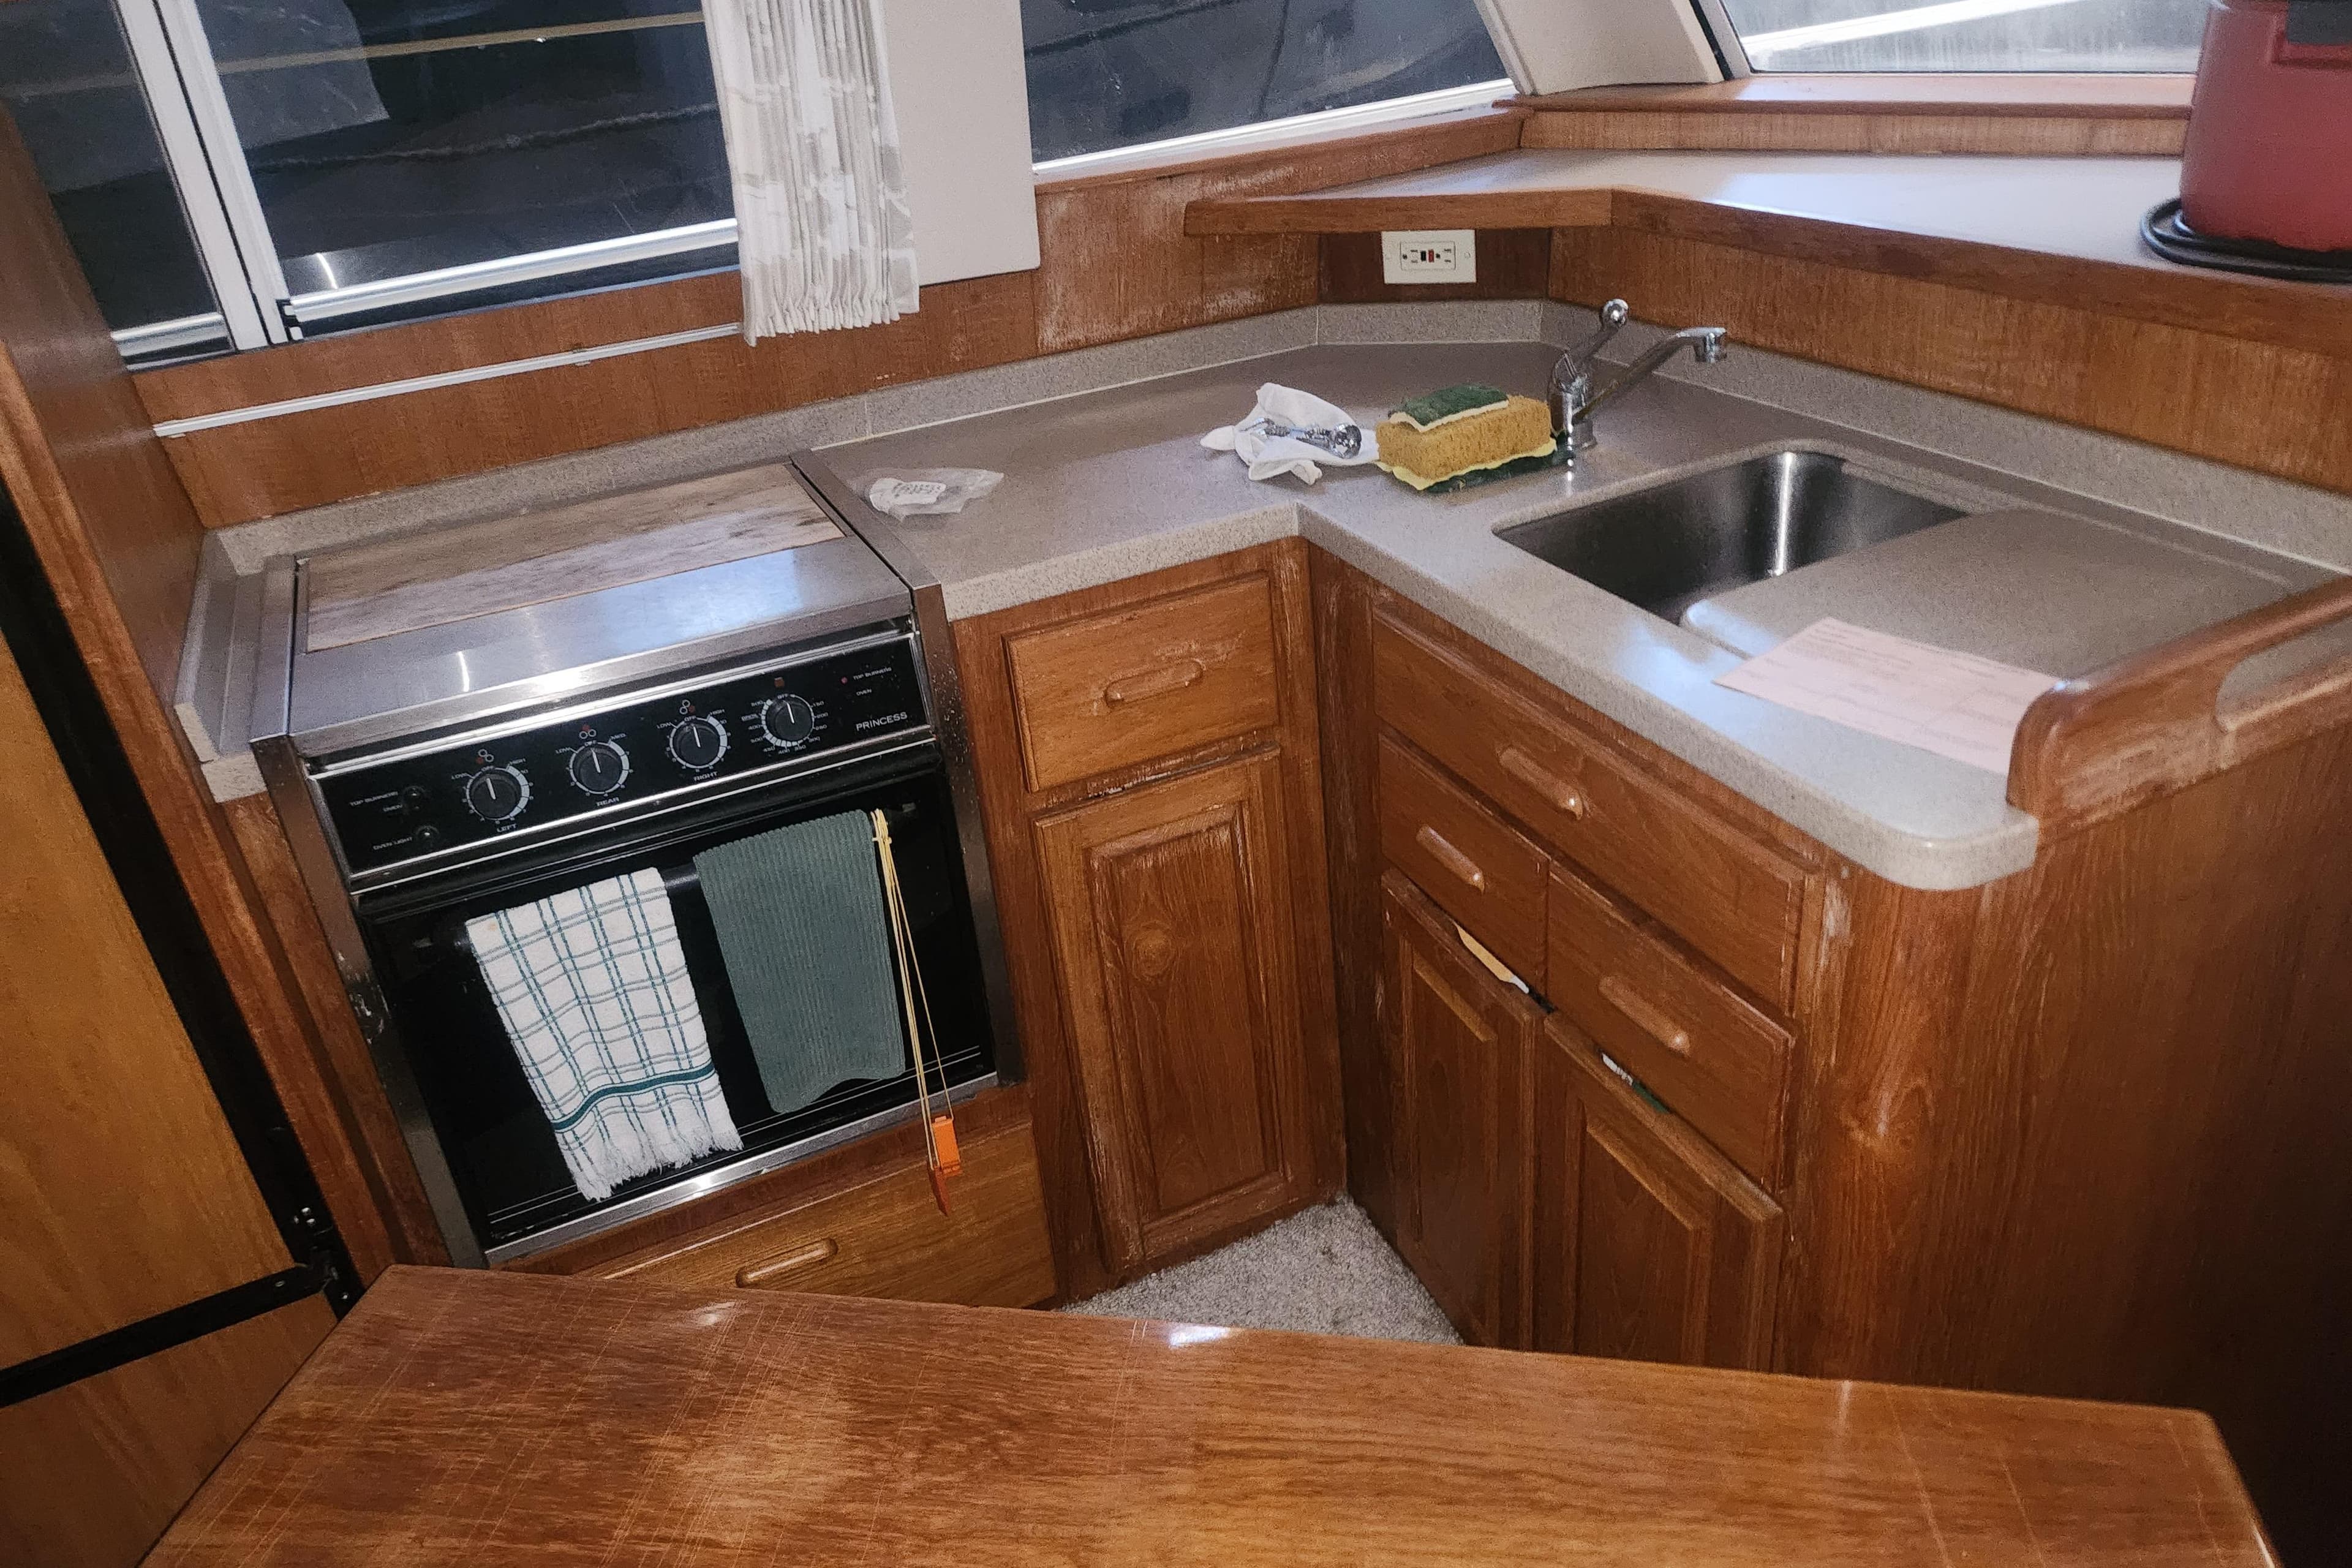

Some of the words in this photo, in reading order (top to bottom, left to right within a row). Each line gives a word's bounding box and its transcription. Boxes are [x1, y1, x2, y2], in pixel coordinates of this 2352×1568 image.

[856, 712, 908, 731] PRINCESS
[693, 772, 717, 782] RIGHT
[596, 797, 620, 807] REAR
[497, 823, 517, 832] LEFT
